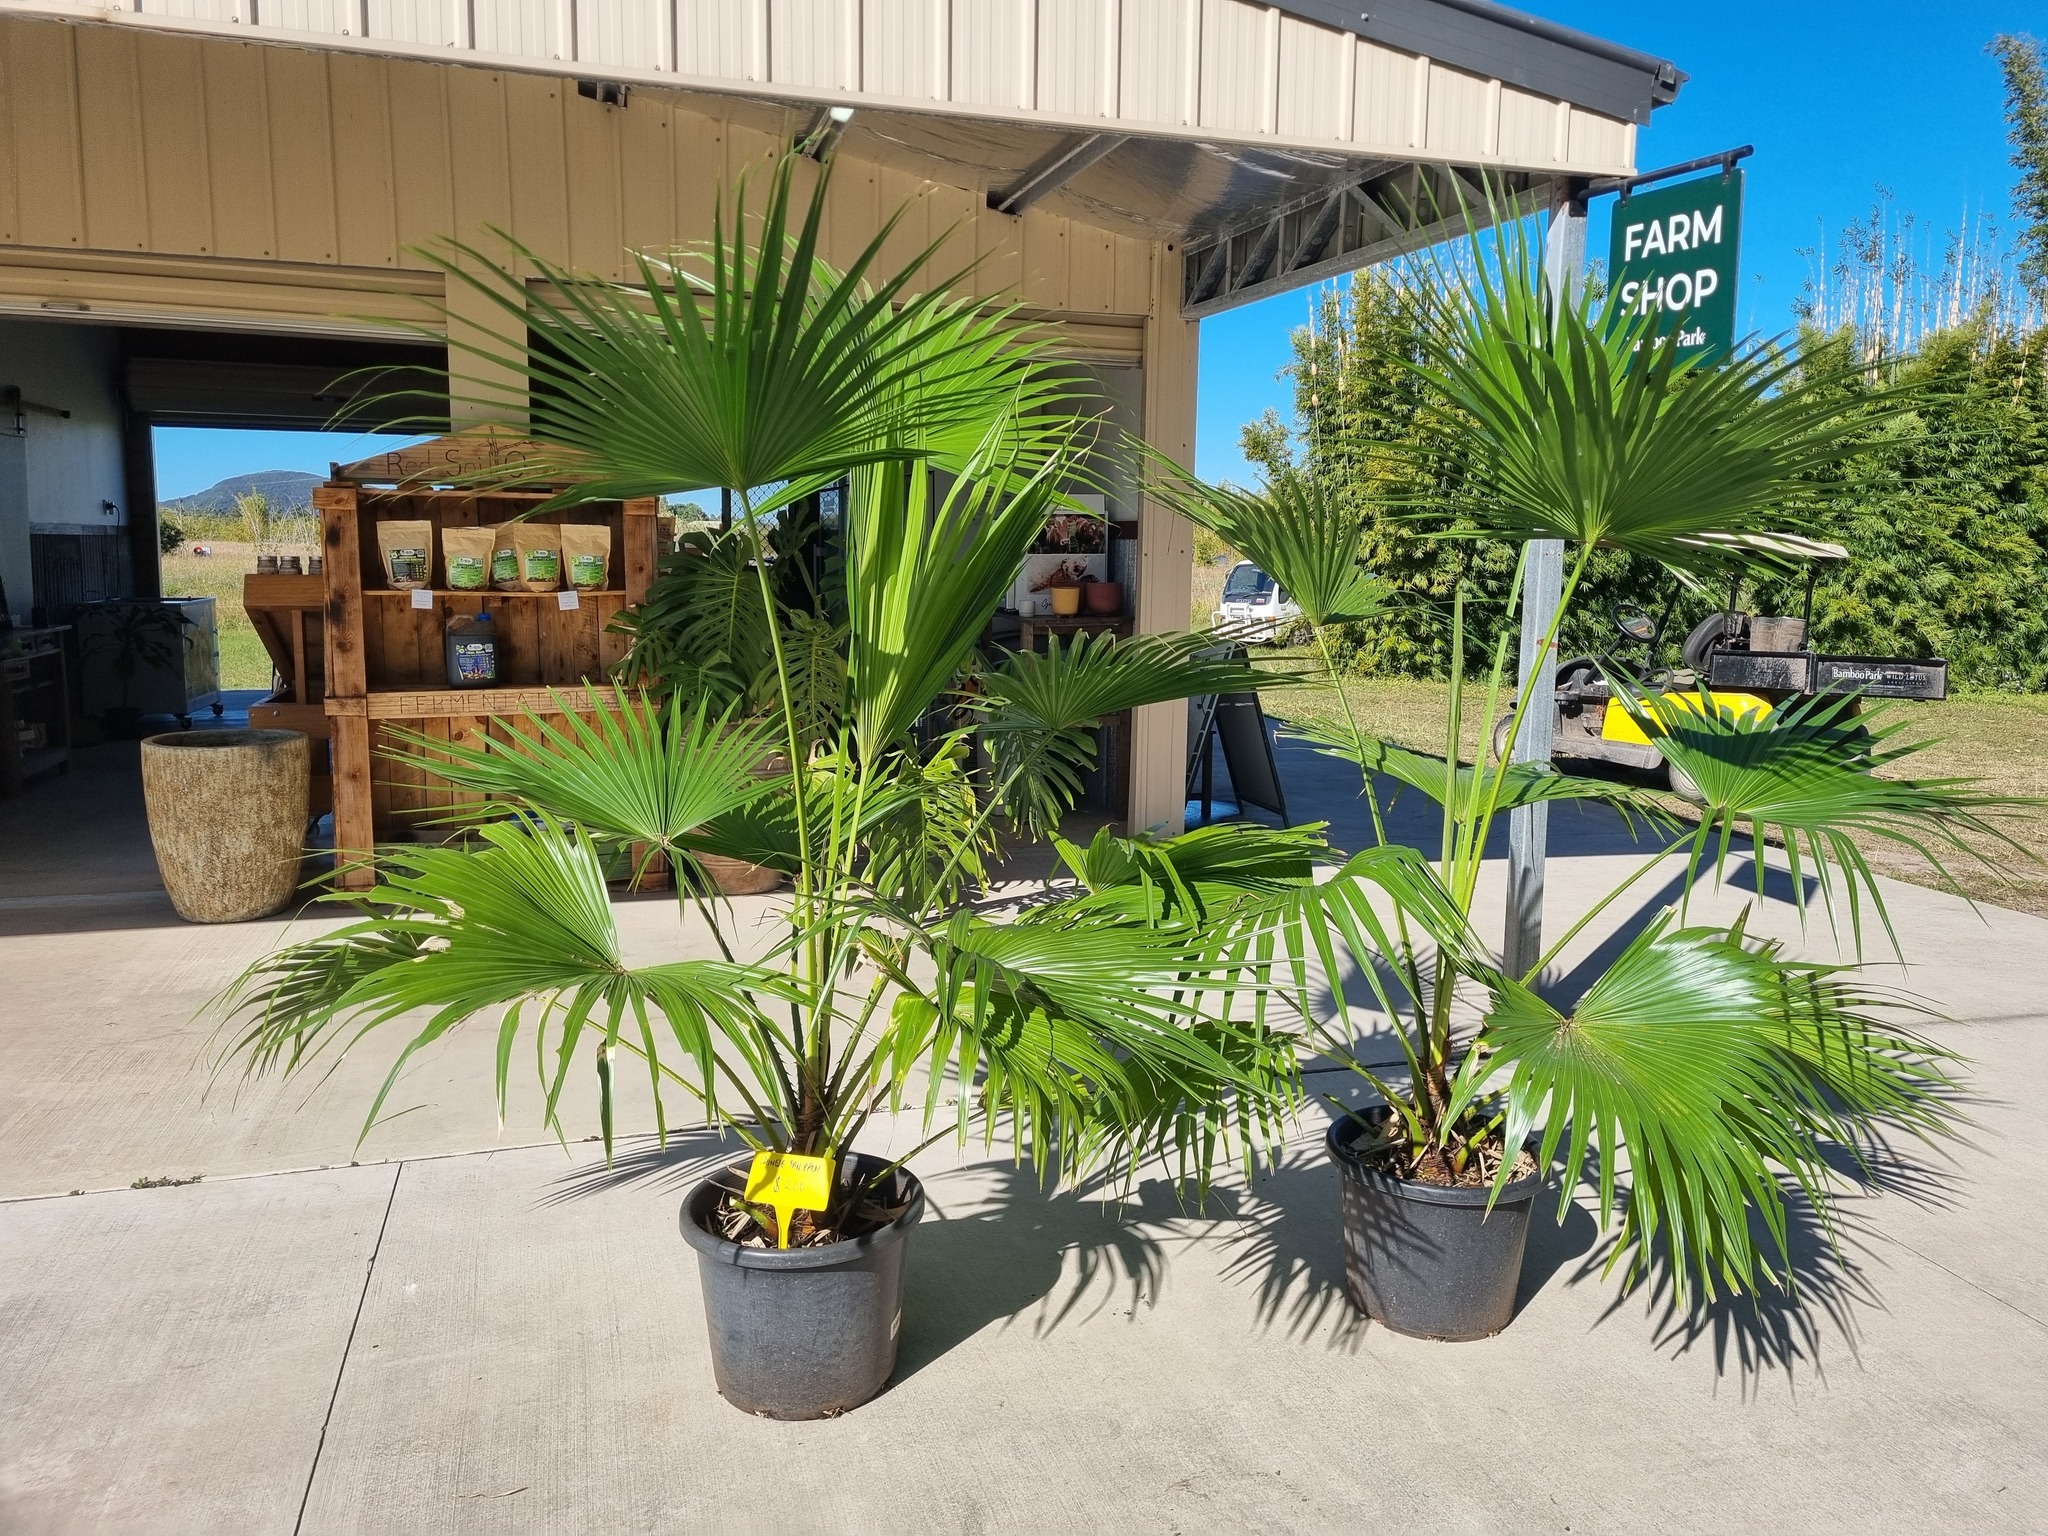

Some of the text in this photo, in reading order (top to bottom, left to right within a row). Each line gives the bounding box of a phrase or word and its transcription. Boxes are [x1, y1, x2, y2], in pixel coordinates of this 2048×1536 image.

[1624, 204, 1723, 262] FARM
[1620, 268, 1718, 316] SHOP
[1676, 326, 1707, 347] Park
[386, 449, 431, 475] Red
[1832, 668, 1865, 680] Bamboo
[1865, 670, 1883, 681] Park
[400, 691, 589, 714] FERMENTATION
